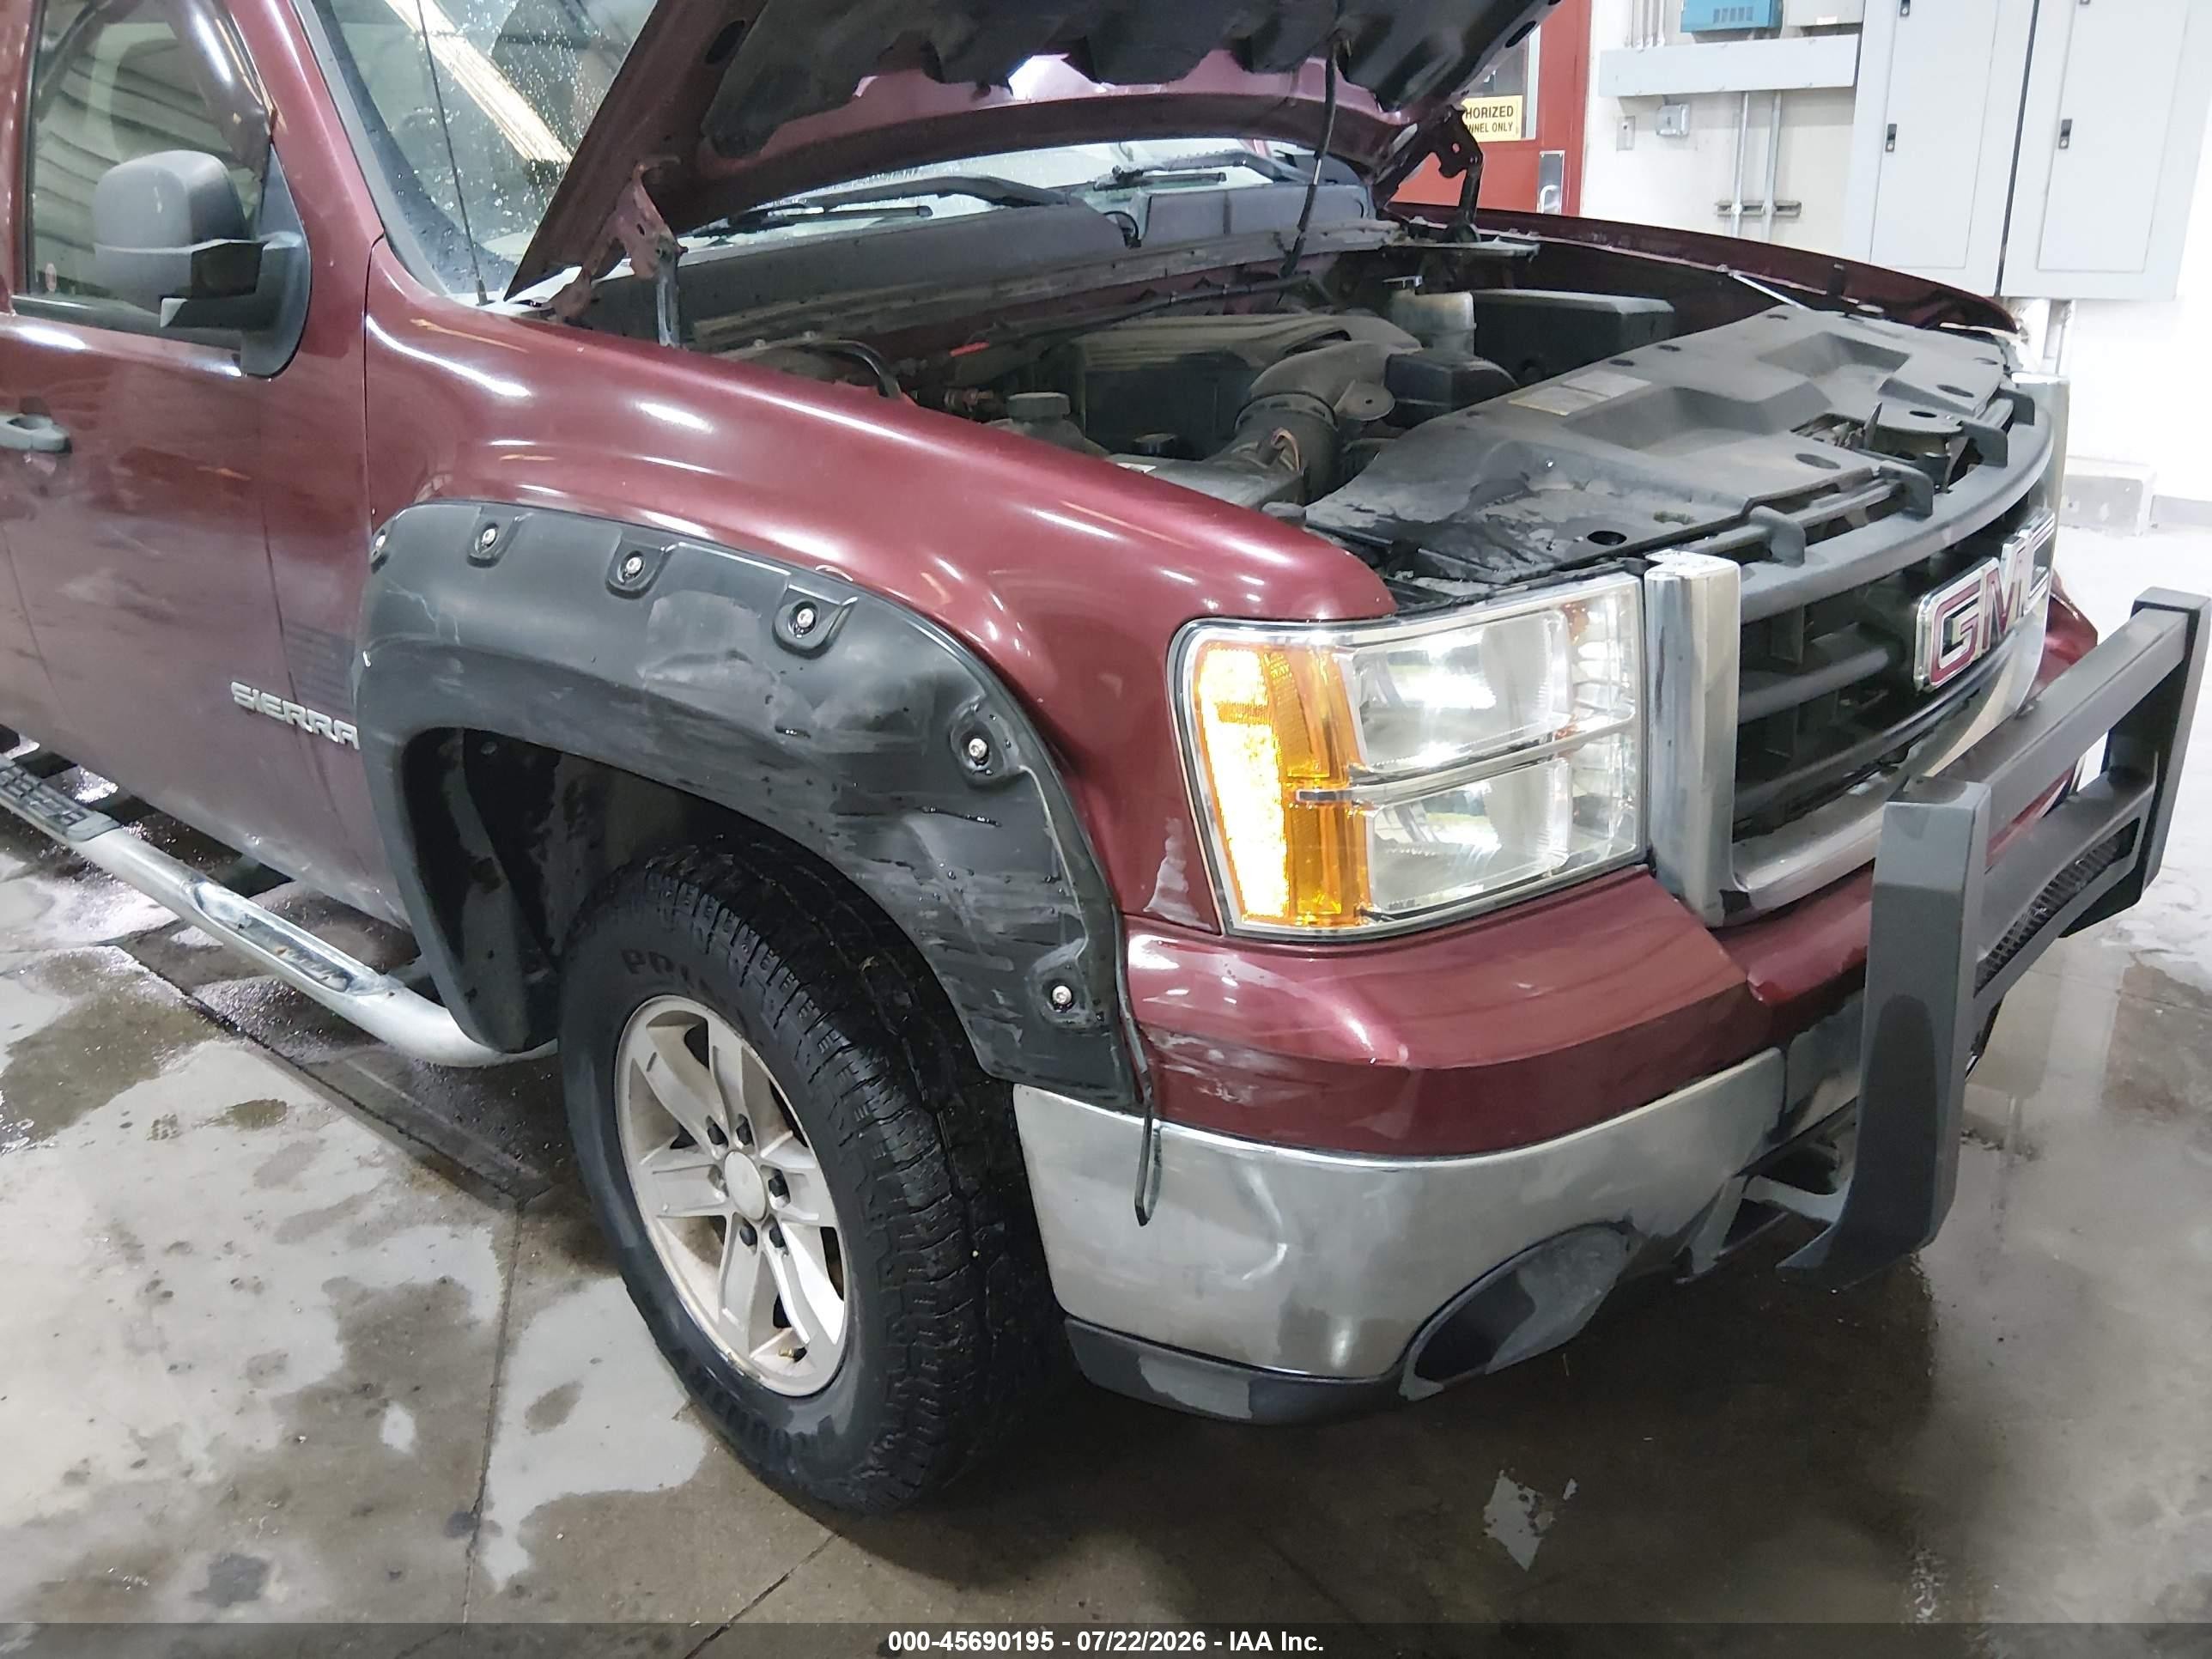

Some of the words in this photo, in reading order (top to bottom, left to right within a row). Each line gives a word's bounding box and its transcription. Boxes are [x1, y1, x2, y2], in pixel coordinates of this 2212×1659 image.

[1465, 106, 1514, 118] HORIZED
[1492, 121, 1513, 132] ONLY
[1914, 514, 2055, 692] GMC
[230, 681, 361, 750] SIERRA
